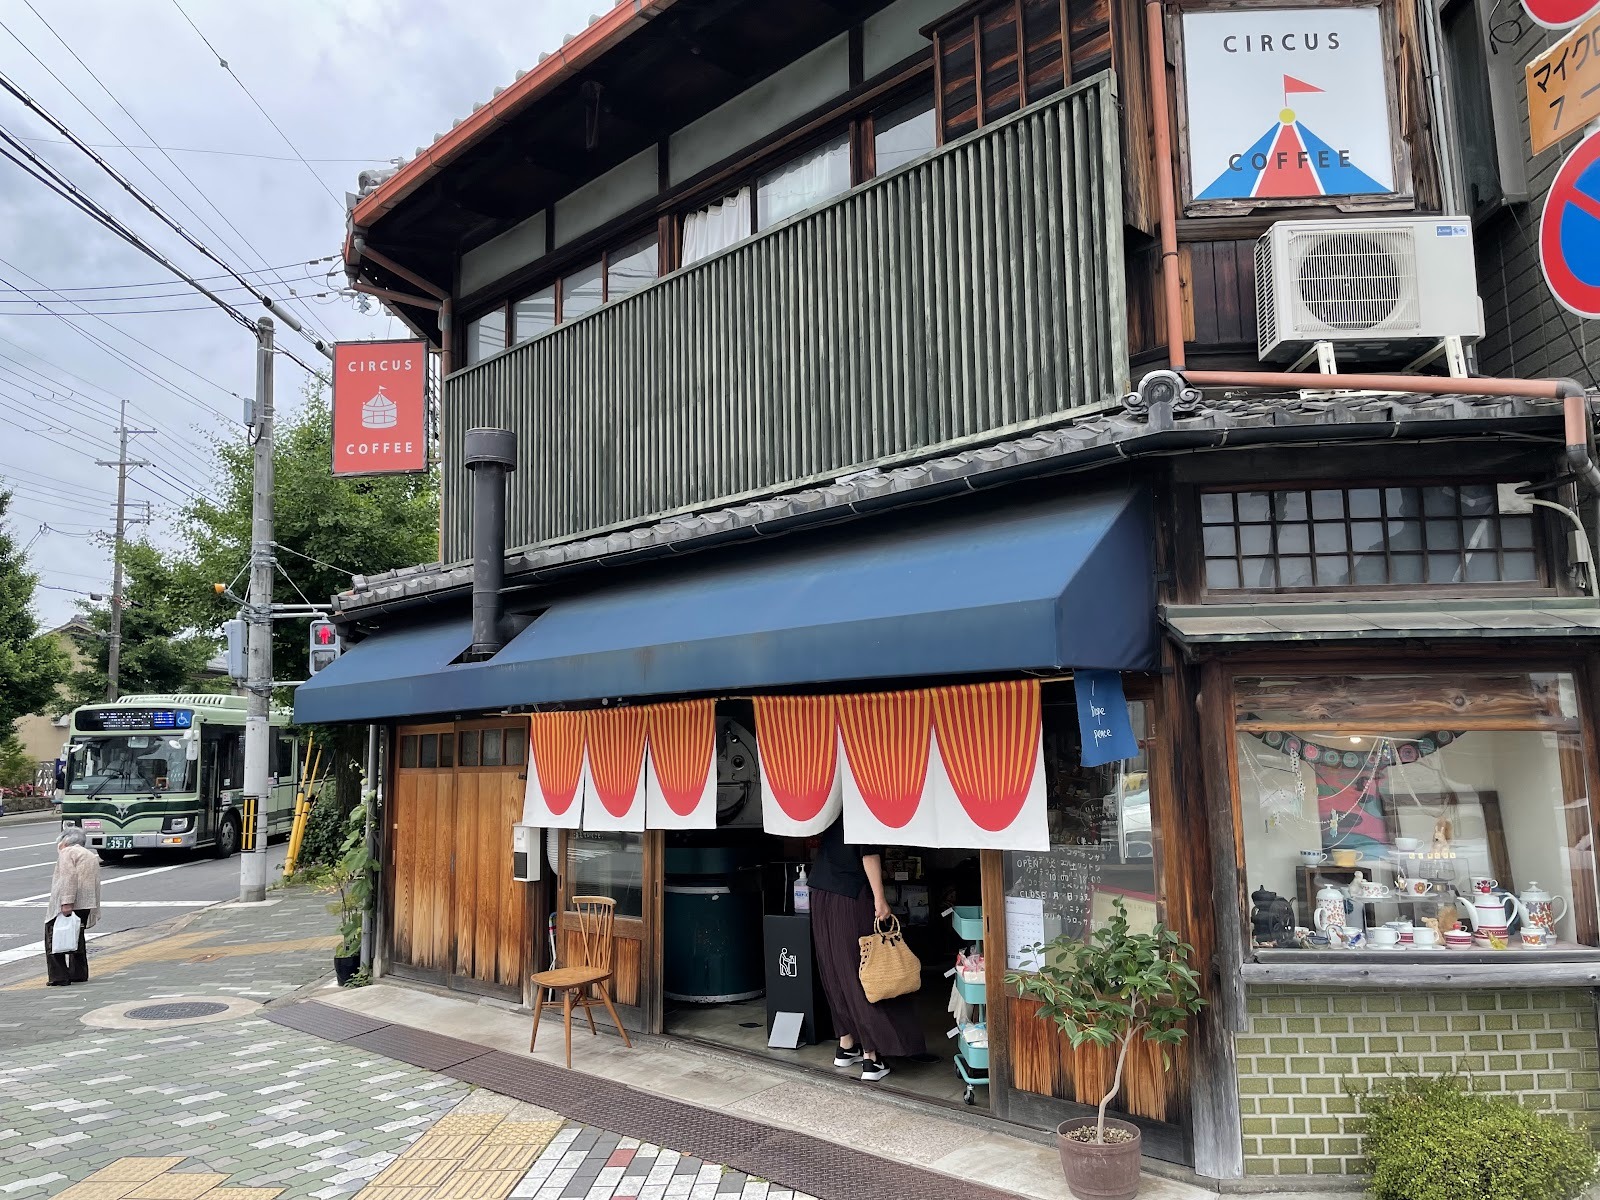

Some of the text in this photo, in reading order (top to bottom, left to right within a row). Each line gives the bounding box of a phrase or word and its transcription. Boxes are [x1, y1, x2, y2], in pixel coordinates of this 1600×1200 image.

[1223, 32, 1340, 53] CIRCUS
[1228, 149, 1351, 171] COFFEE
[348, 359, 412, 372] CIRCUS
[346, 441, 413, 455] COFFEE
[1089, 700, 1106, 725] hope
[1093, 729, 1112, 747] peace
[110, 839, 132, 848] 39-16
[1016, 859, 1039, 868] OPEN
[1019, 890, 1047, 900] CLOSE
